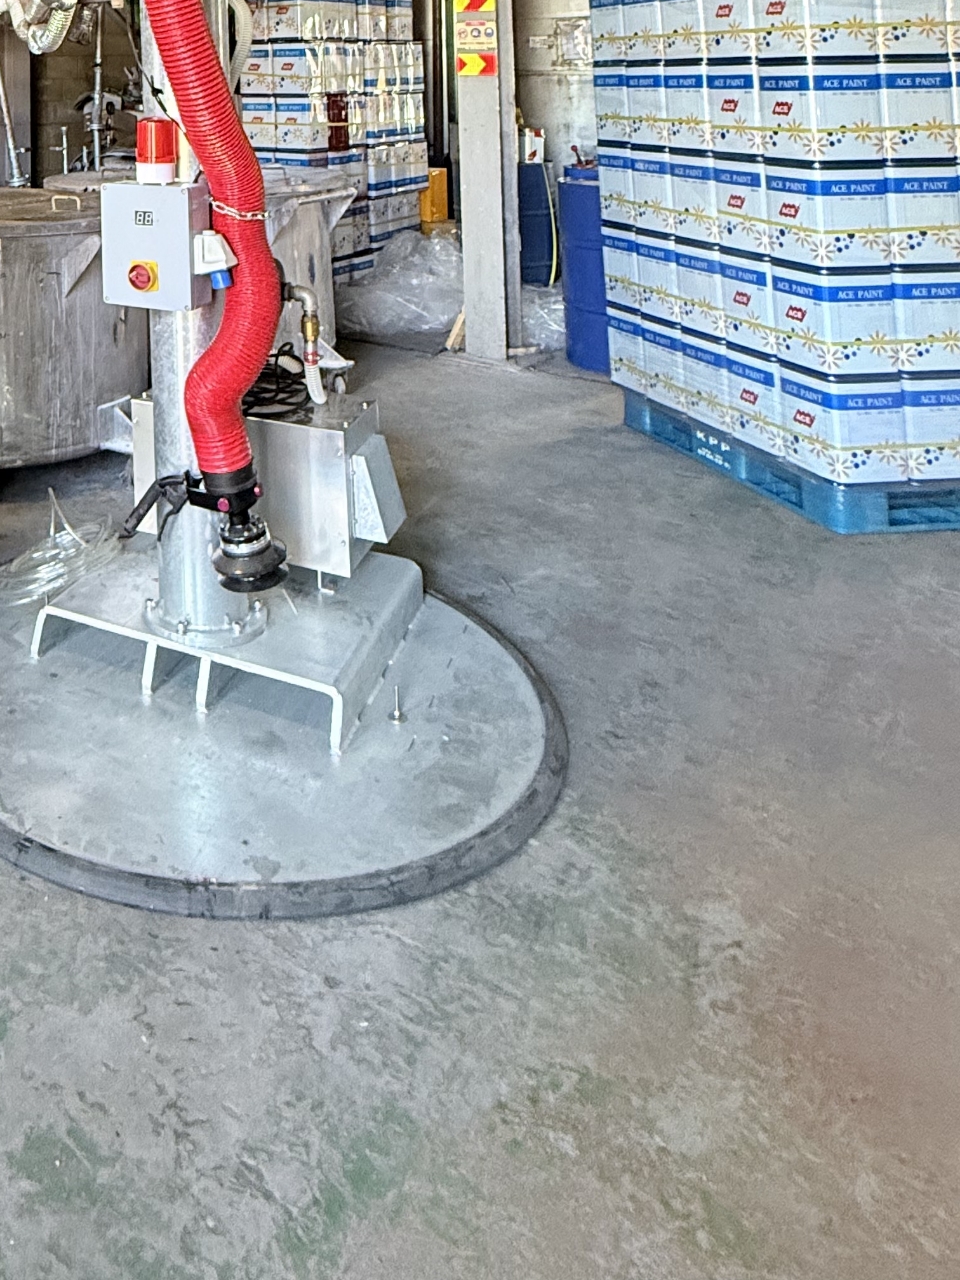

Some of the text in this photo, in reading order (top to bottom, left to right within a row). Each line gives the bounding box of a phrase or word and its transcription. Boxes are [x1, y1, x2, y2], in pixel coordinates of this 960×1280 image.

[679, 78, 696, 86] PAINT
[726, 78, 744, 86] PAINT
[763, 79, 800, 88] ACE PAINT
[823, 78, 869, 88] ACE PAINT
[895, 77, 941, 86] ACE PAINT
[732, 174, 752, 184] PAINT
[770, 180, 807, 192] ACE PAINT
[830, 183, 877, 193] ACE PAINT
[903, 181, 949, 190] ACE PAINT
[725, 268, 758, 282] ACE PAINT
[776, 281, 814, 296] ACE PAINT
[912, 287, 957, 296] ACE PAINT
[837, 289, 884, 299] ACE PAINT
[744, 368, 765, 381] PAINT
[785, 383, 823, 402] ACE PAINT
[847, 397, 893, 407] ACE PAINT
[920, 394, 938, 404] ACE
